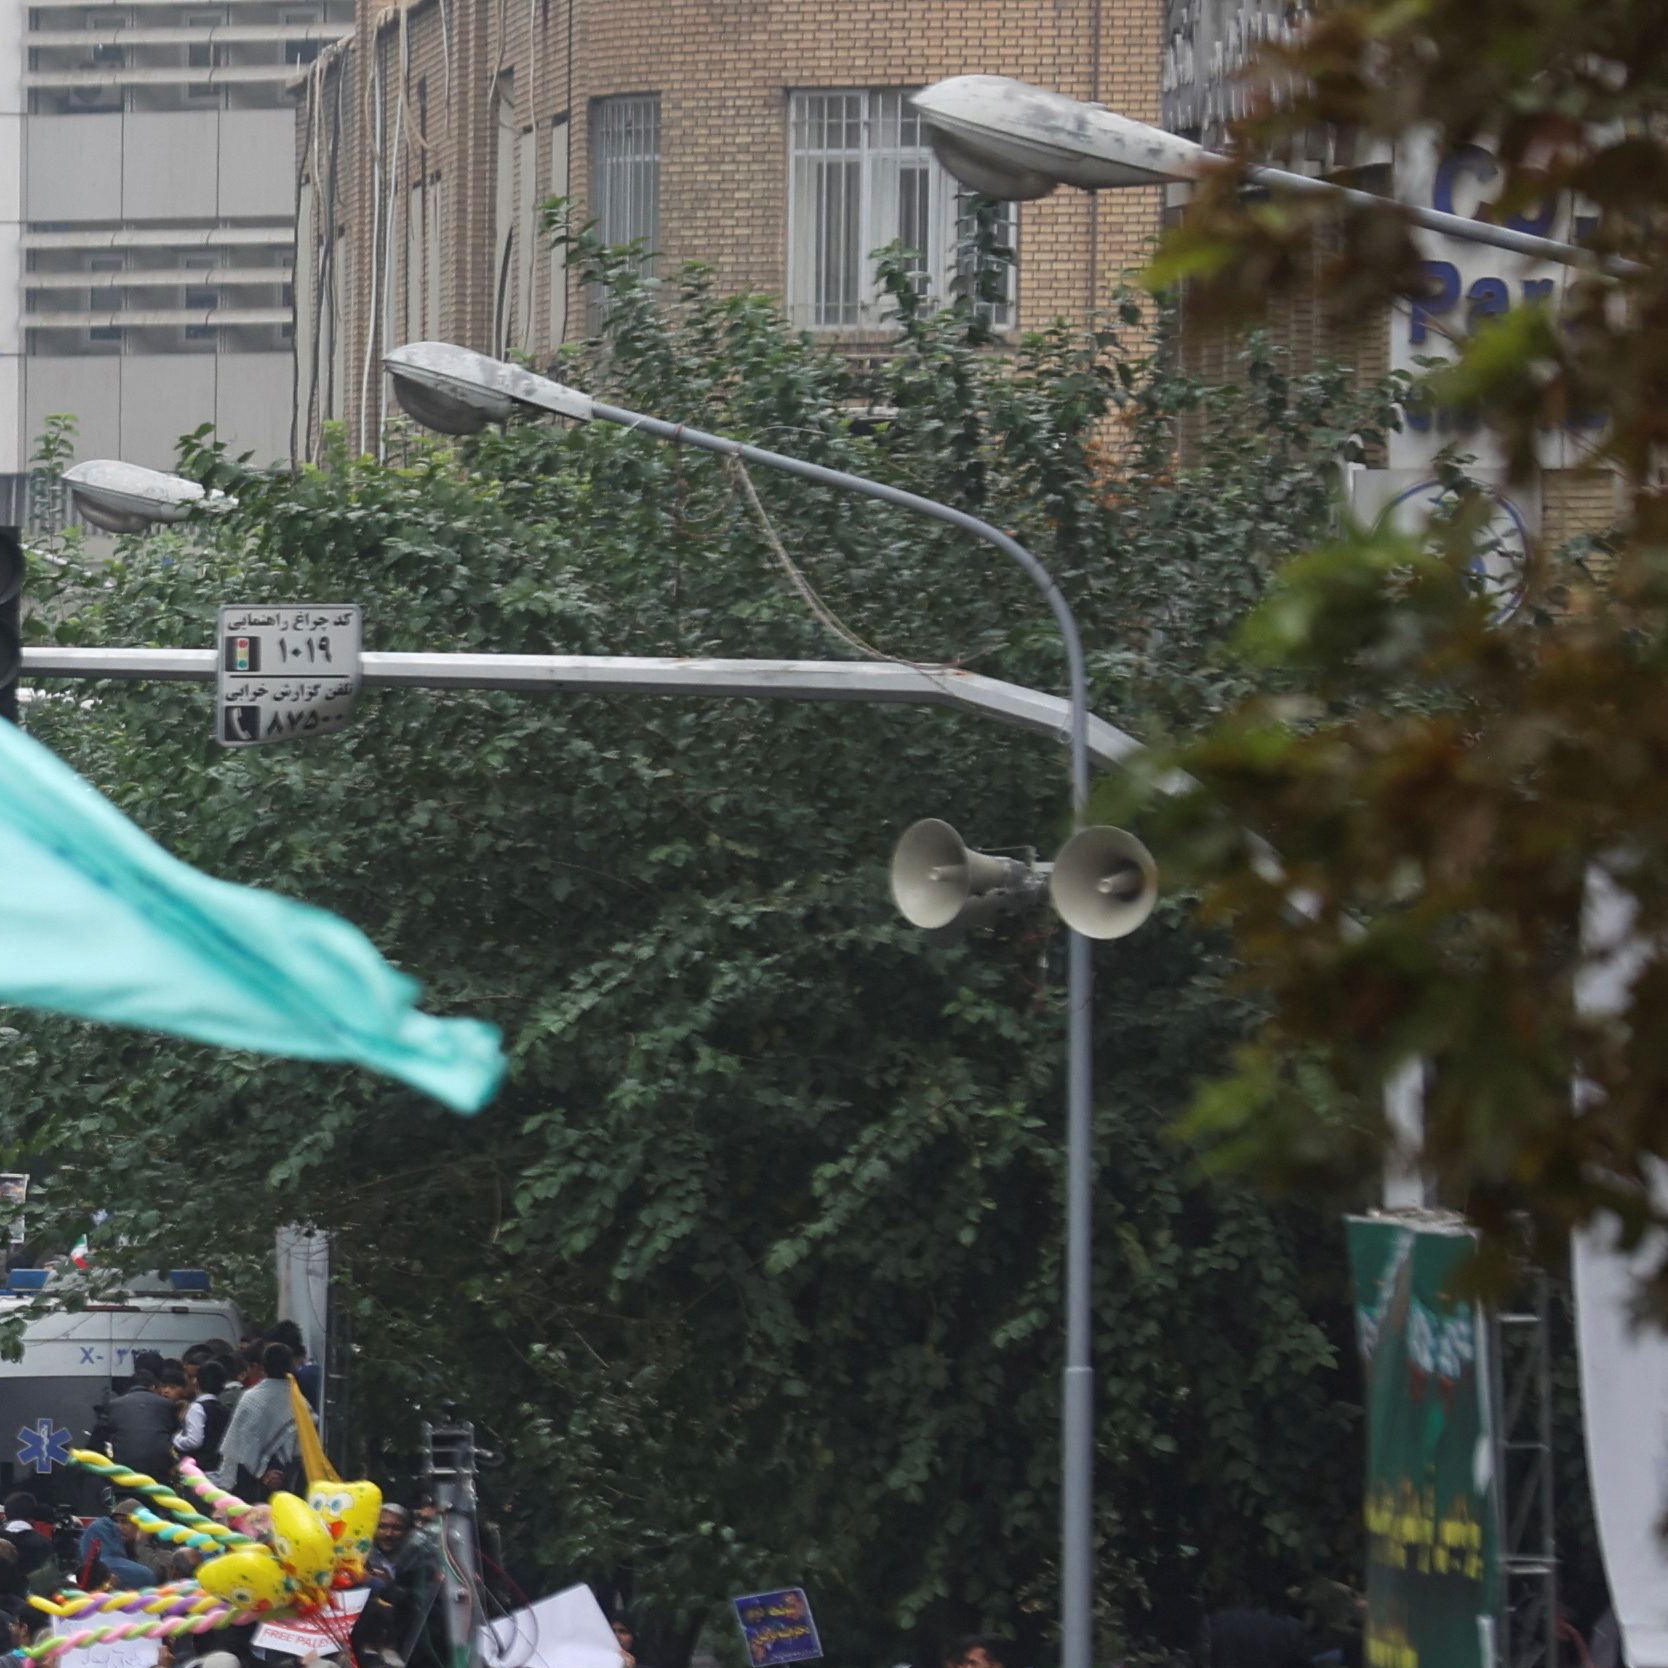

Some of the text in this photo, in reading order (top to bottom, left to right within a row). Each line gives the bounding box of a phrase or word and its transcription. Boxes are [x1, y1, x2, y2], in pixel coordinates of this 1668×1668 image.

[227, 611, 353, 631] کد چراغ راهنمایی
[279, 636, 332, 664] ۱۰۱۹
[226, 684, 354, 702] تلفن گزارش خرابی
[267, 710, 344, 736] ۸۷۵۰۰
[264, 1627, 296, 1642] FREE
